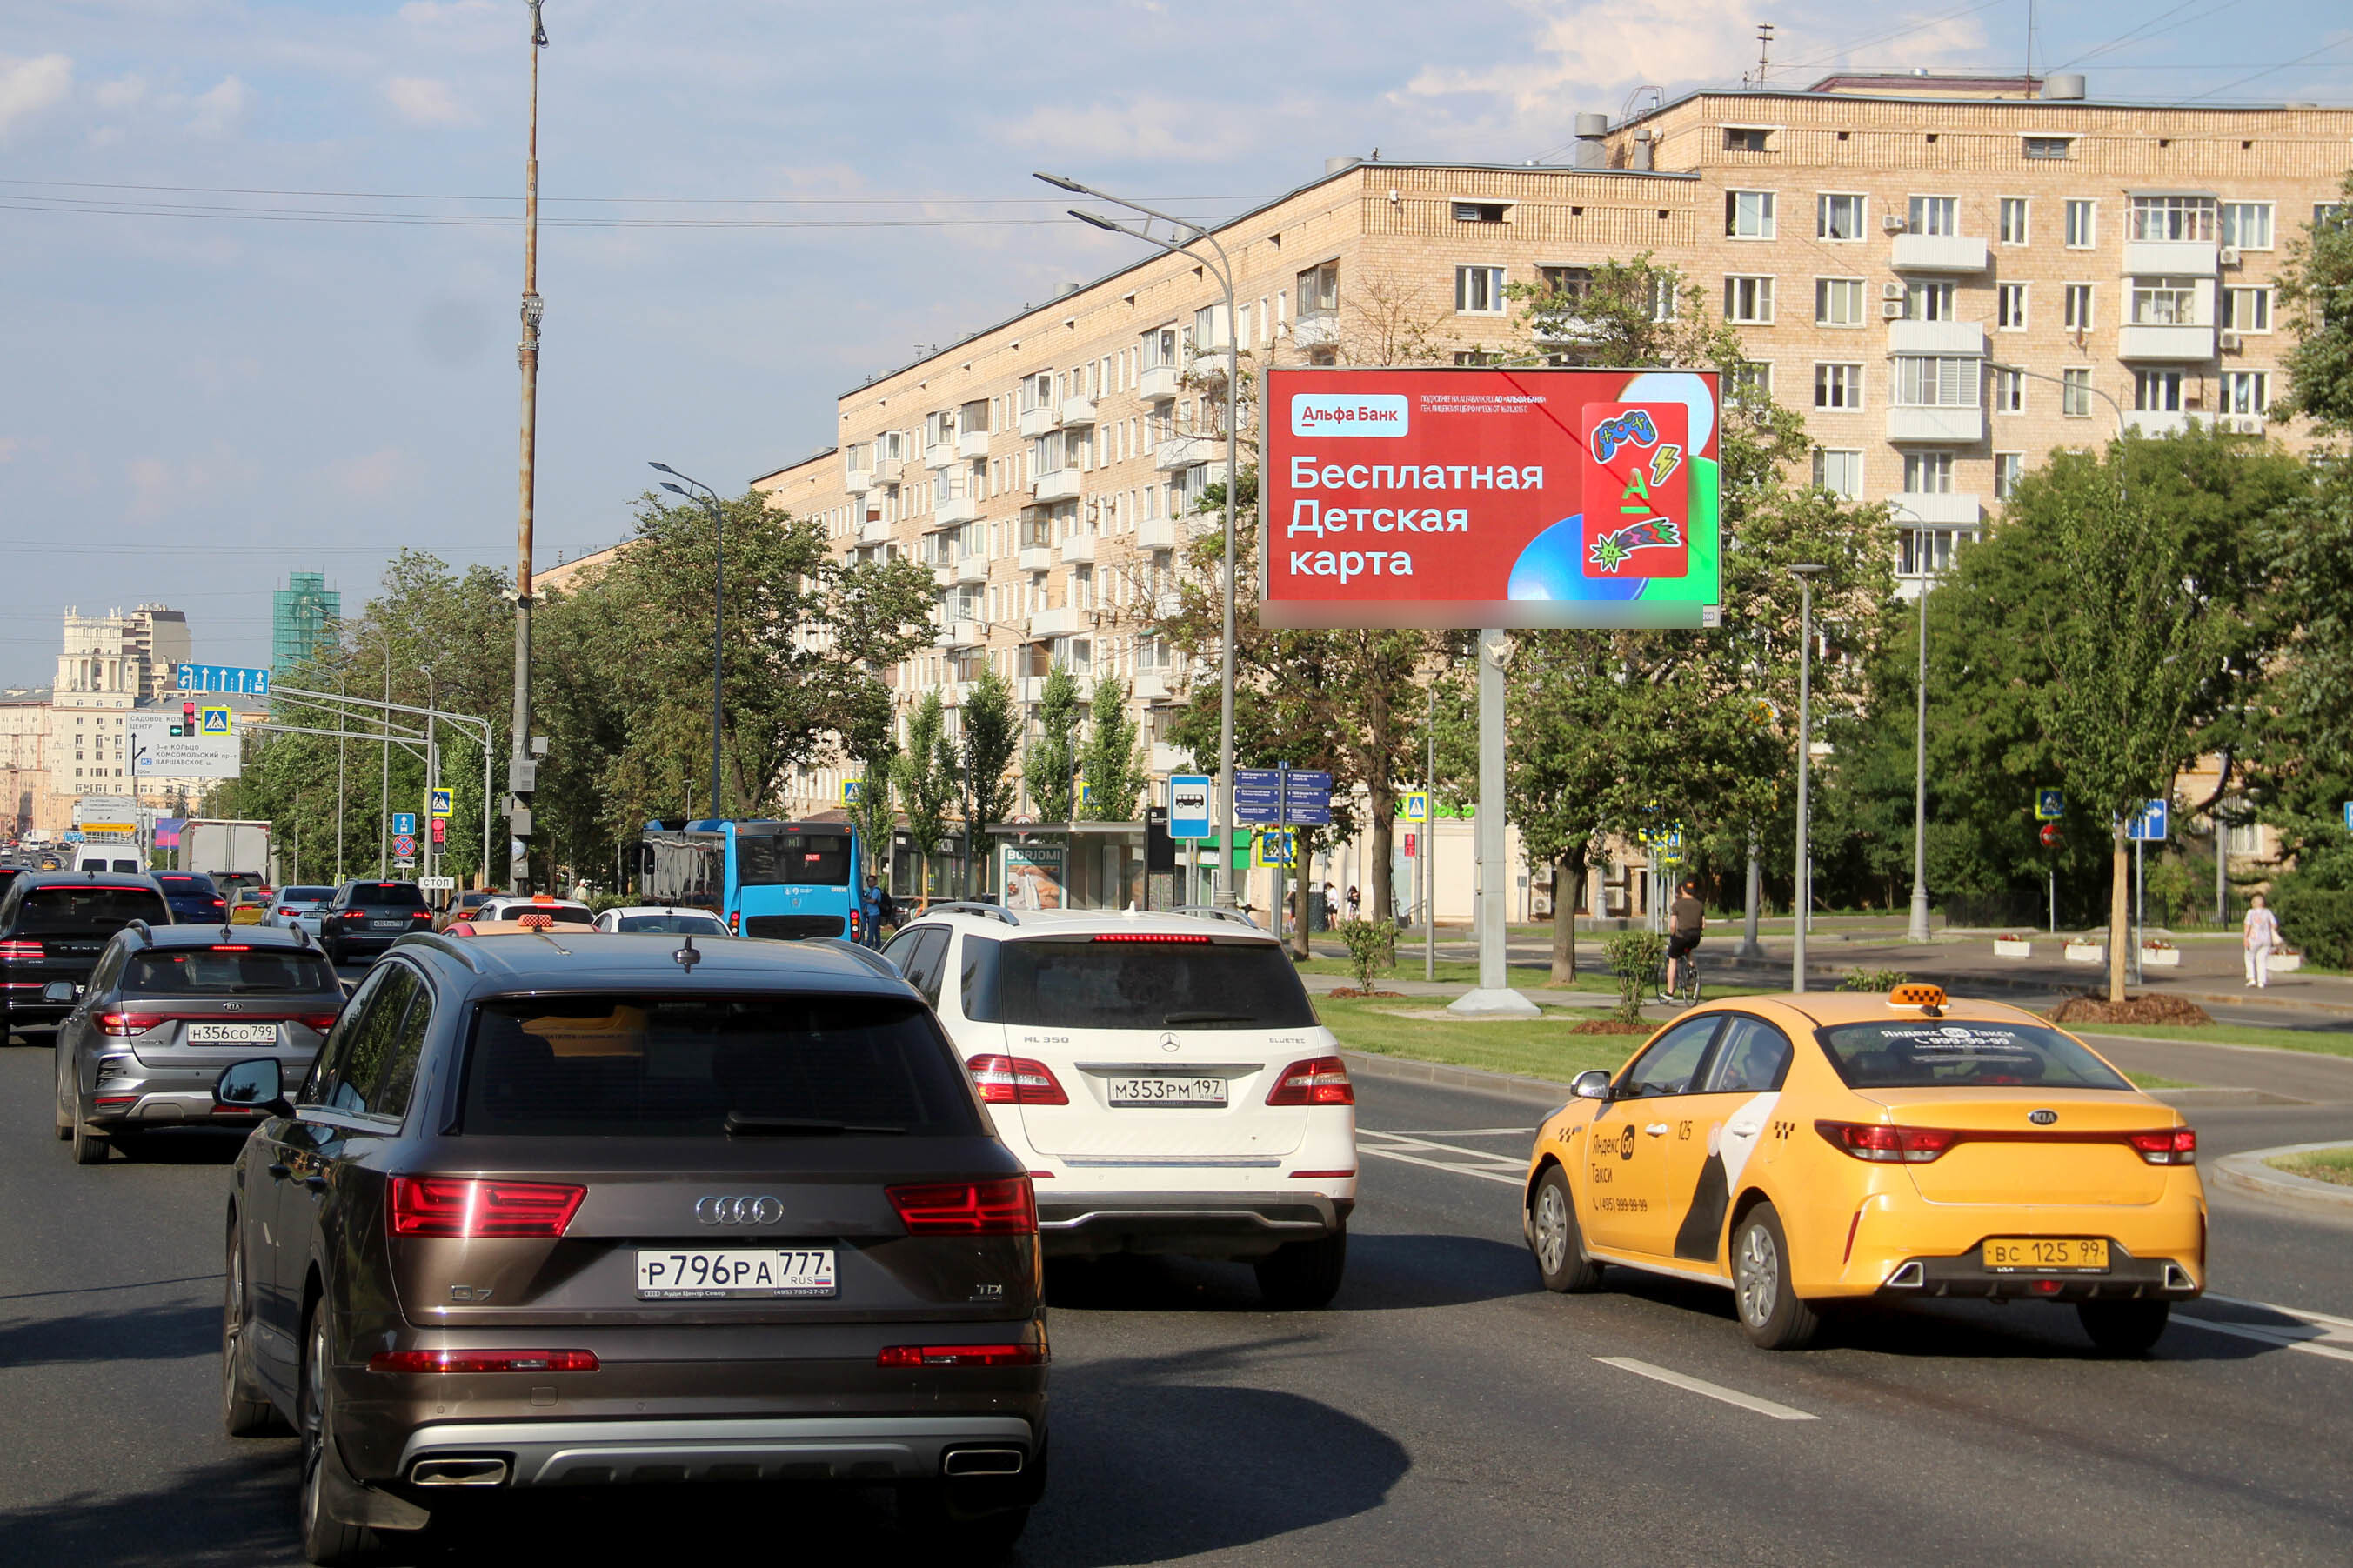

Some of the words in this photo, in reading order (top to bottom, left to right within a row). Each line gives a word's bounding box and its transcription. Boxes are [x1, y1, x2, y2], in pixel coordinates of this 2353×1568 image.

[1302, 406, 1354, 424] Альфа
[1358, 406, 1398, 421] Банк
[1291, 456, 1543, 490] Бесплатная
[1287, 499, 1468, 538] Детская
[1290, 550, 1413, 584] карта
[1007, 850, 1060, 860] BORJOMI
[193, 1026, 249, 1039] Н356СО
[251, 1026, 272, 1036] 799
[1115, 1080, 1191, 1098] М353РМ
[1193, 1080, 1220, 1093] 197
[2033, 1111, 2055, 1123] KIA
[1678, 1120, 1693, 1140] 125
[1593, 1135, 1620, 1156] Яндекс
[1591, 1164, 1613, 1183] Такси
[1600, 1199, 1616, 1211] (495)
[1616, 1198, 1648, 1211] 999-99-99
[1995, 1246, 2020, 1261] ВС
[2032, 1242, 2069, 1262] 125
[2080, 1242, 2099, 1257] 99
[648, 1255, 772, 1285] Р796РА
[779, 1252, 825, 1274] 777
[791, 1276, 814, 1285] RUS
[976, 1284, 1003, 1295] TDI
